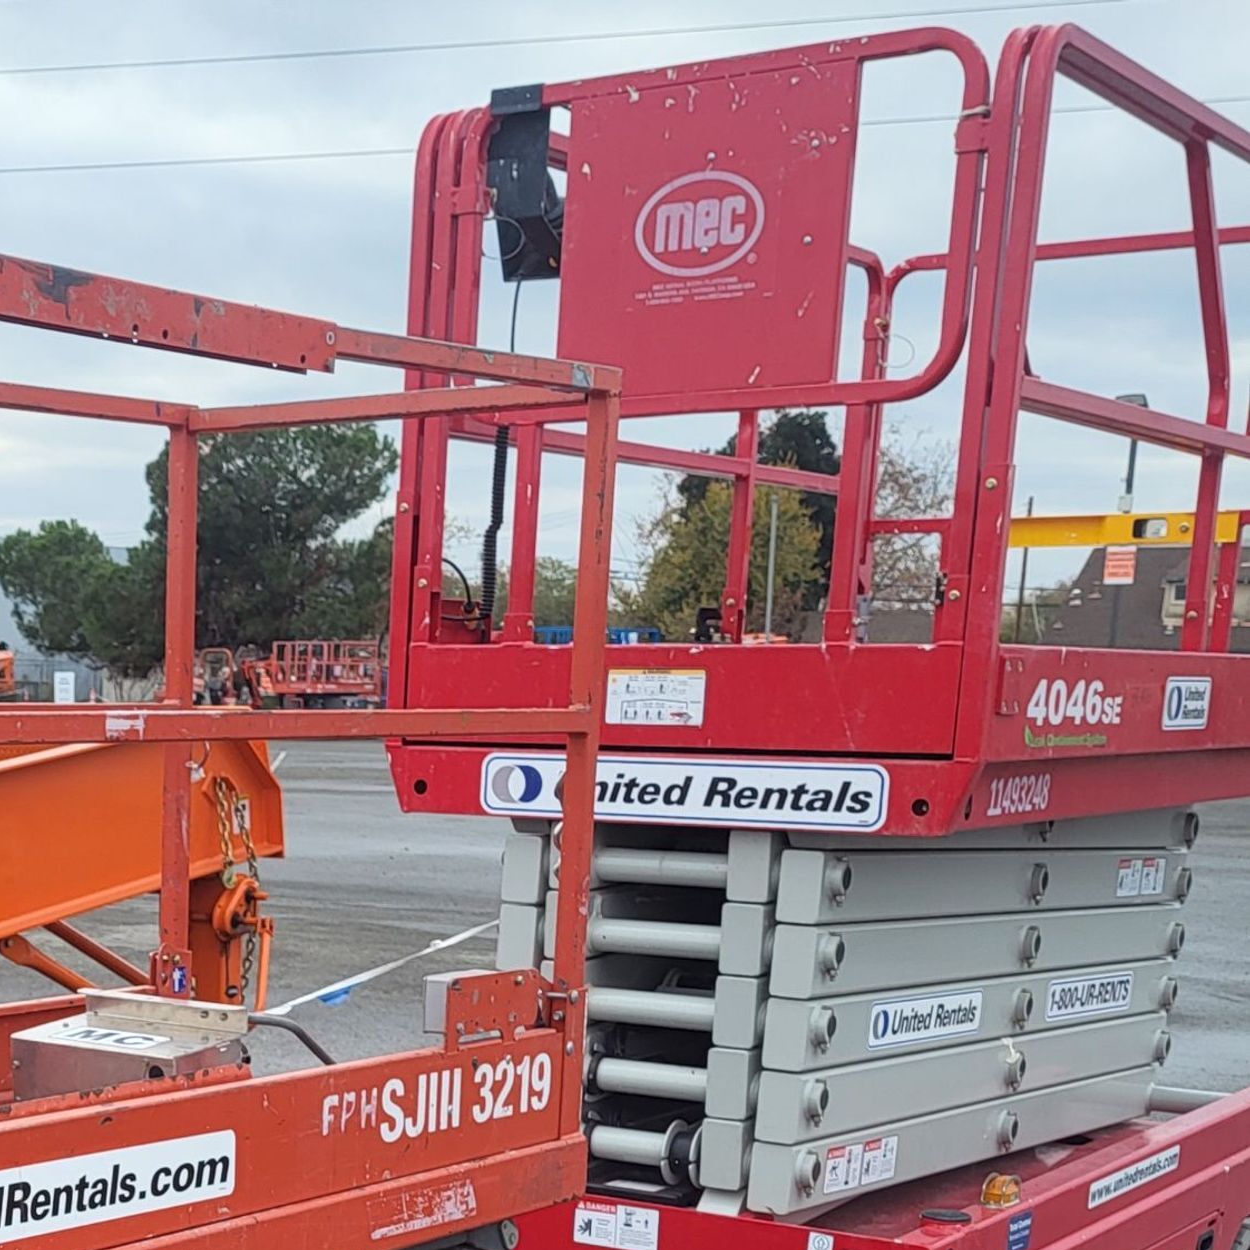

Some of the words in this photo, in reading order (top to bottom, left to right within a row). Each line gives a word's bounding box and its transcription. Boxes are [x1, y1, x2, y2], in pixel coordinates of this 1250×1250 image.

[654, 194, 746, 253] mec
[703, 777, 873, 814] Rentals
[891, 1004, 934, 1036] United
[934, 999, 977, 1029] Rentals
[472, 1052, 552, 1124] 3219
